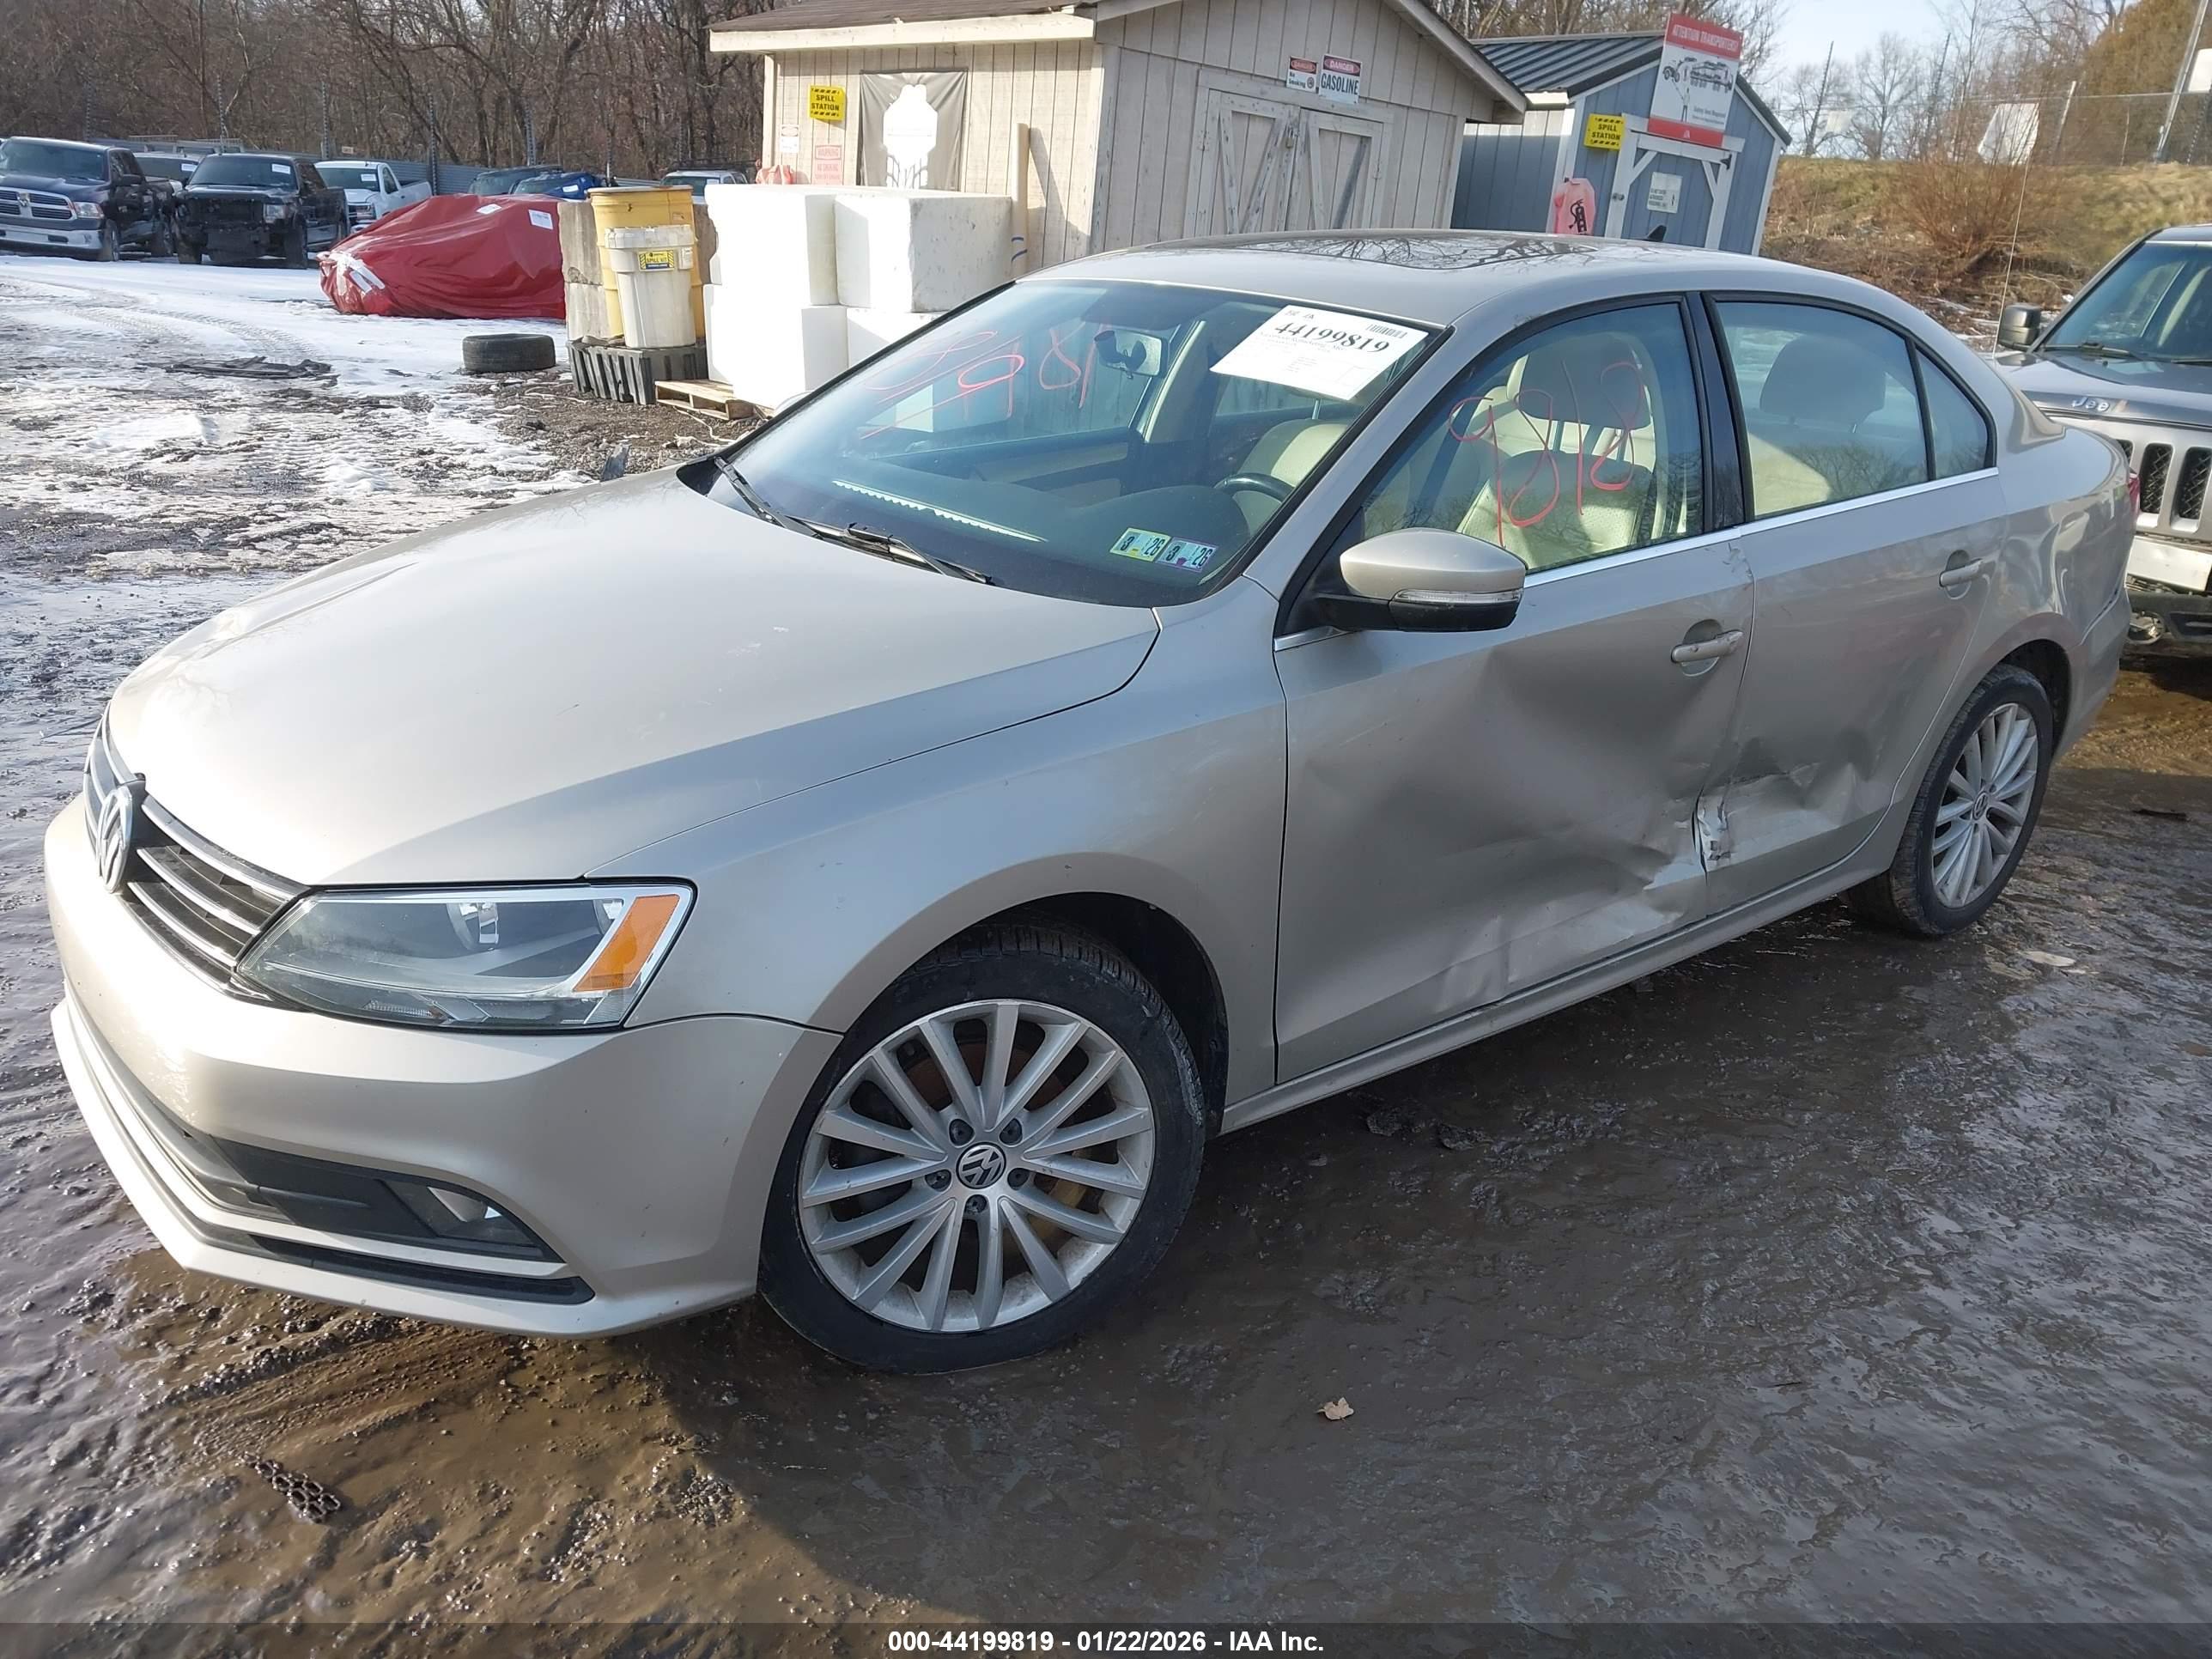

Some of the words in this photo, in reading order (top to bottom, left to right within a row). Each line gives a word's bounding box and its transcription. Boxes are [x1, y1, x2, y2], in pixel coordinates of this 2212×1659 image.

[1330, 60, 1354, 72] DANGER
[1289, 78, 1306, 88] Smoking
[1321, 73, 1359, 94] GASOLINE
[1591, 131, 1621, 140] STATION
[1273, 322, 1390, 353] 44199819
[1120, 536, 1135, 551] 3
[1143, 538, 1166, 556] 26
[1165, 545, 1181, 562] 3
[1191, 547, 1213, 567] 26
